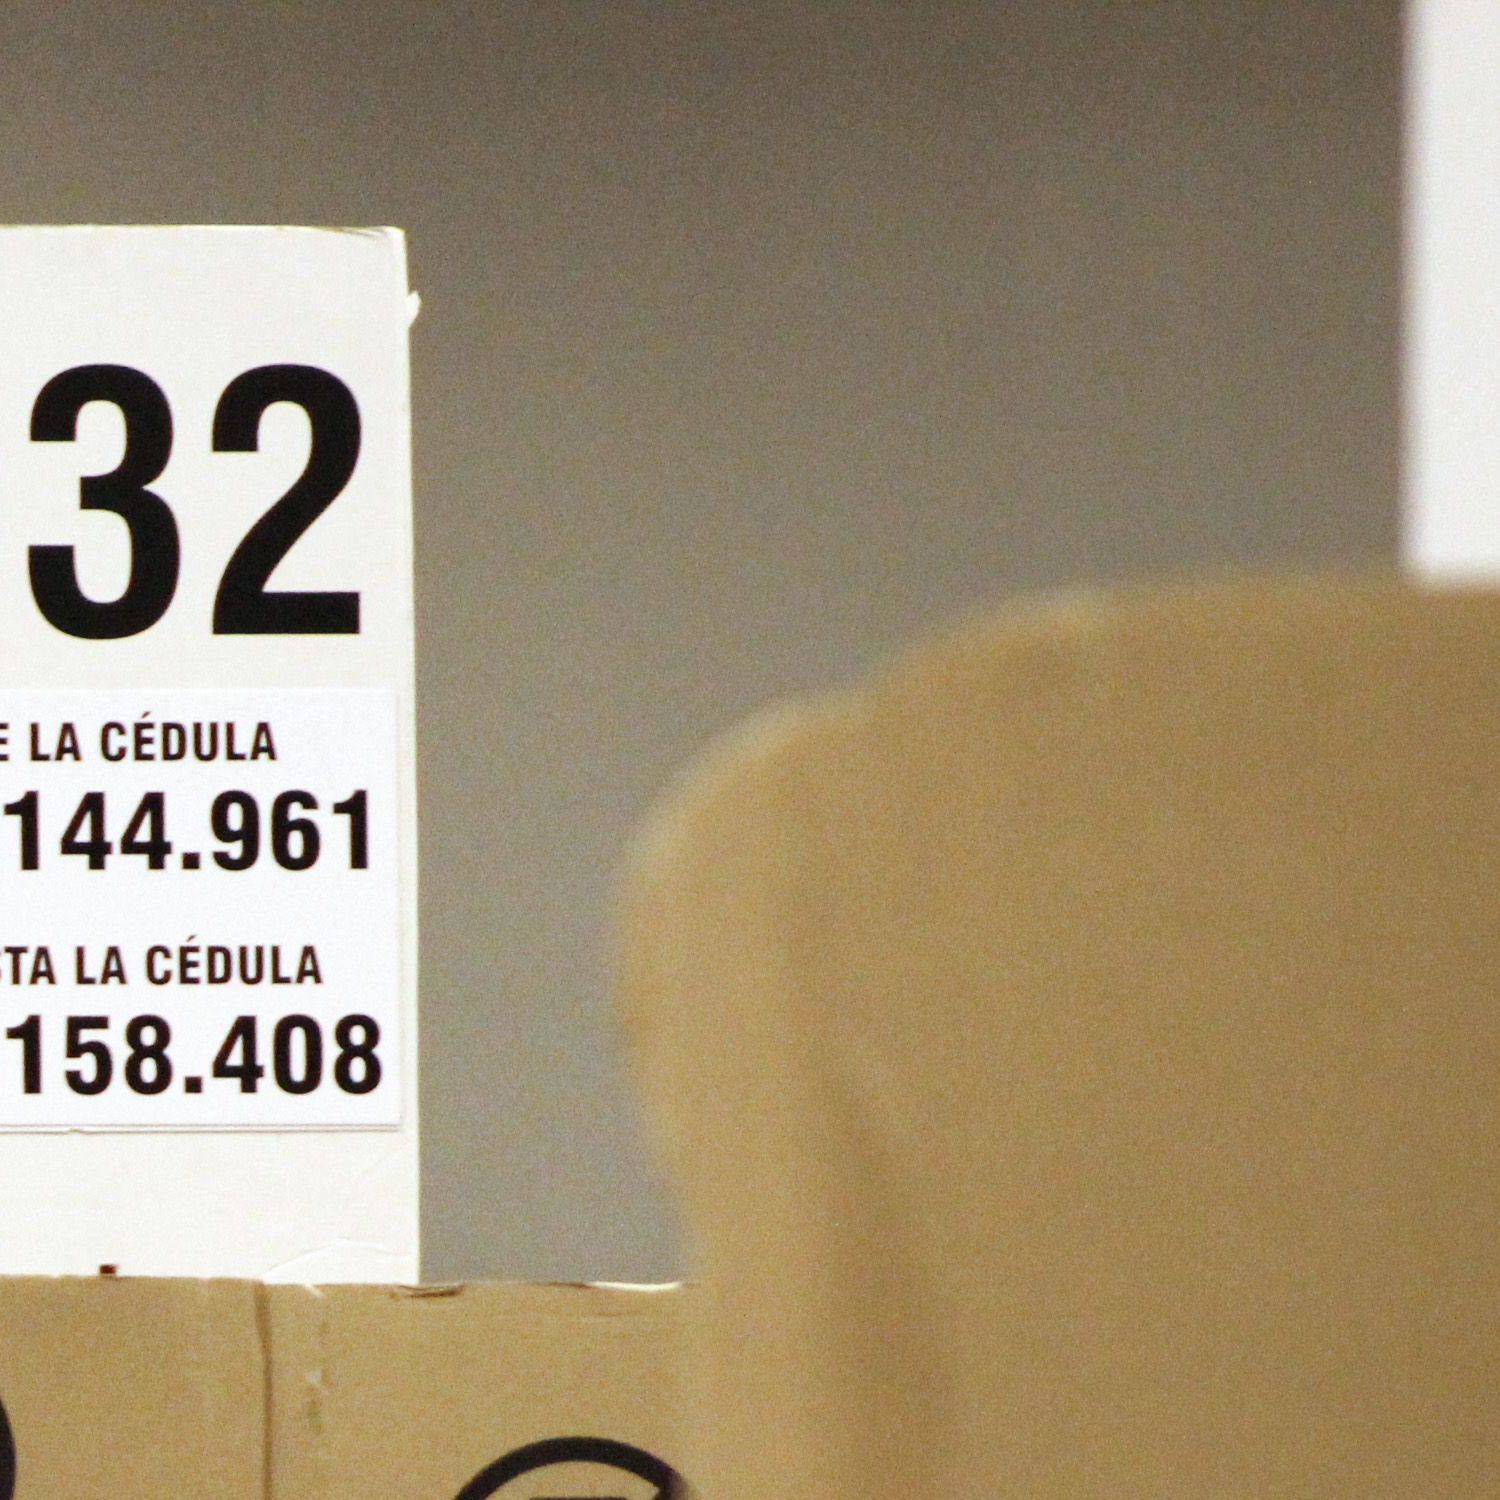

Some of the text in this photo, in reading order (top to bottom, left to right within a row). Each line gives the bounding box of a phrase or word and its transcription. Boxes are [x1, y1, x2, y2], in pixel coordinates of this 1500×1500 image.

[30, 722, 82, 762] LA
[101, 711, 277, 763] CÉDULA
[75, 945, 127, 986] LA
[145, 936, 323, 986] CÉDULA
